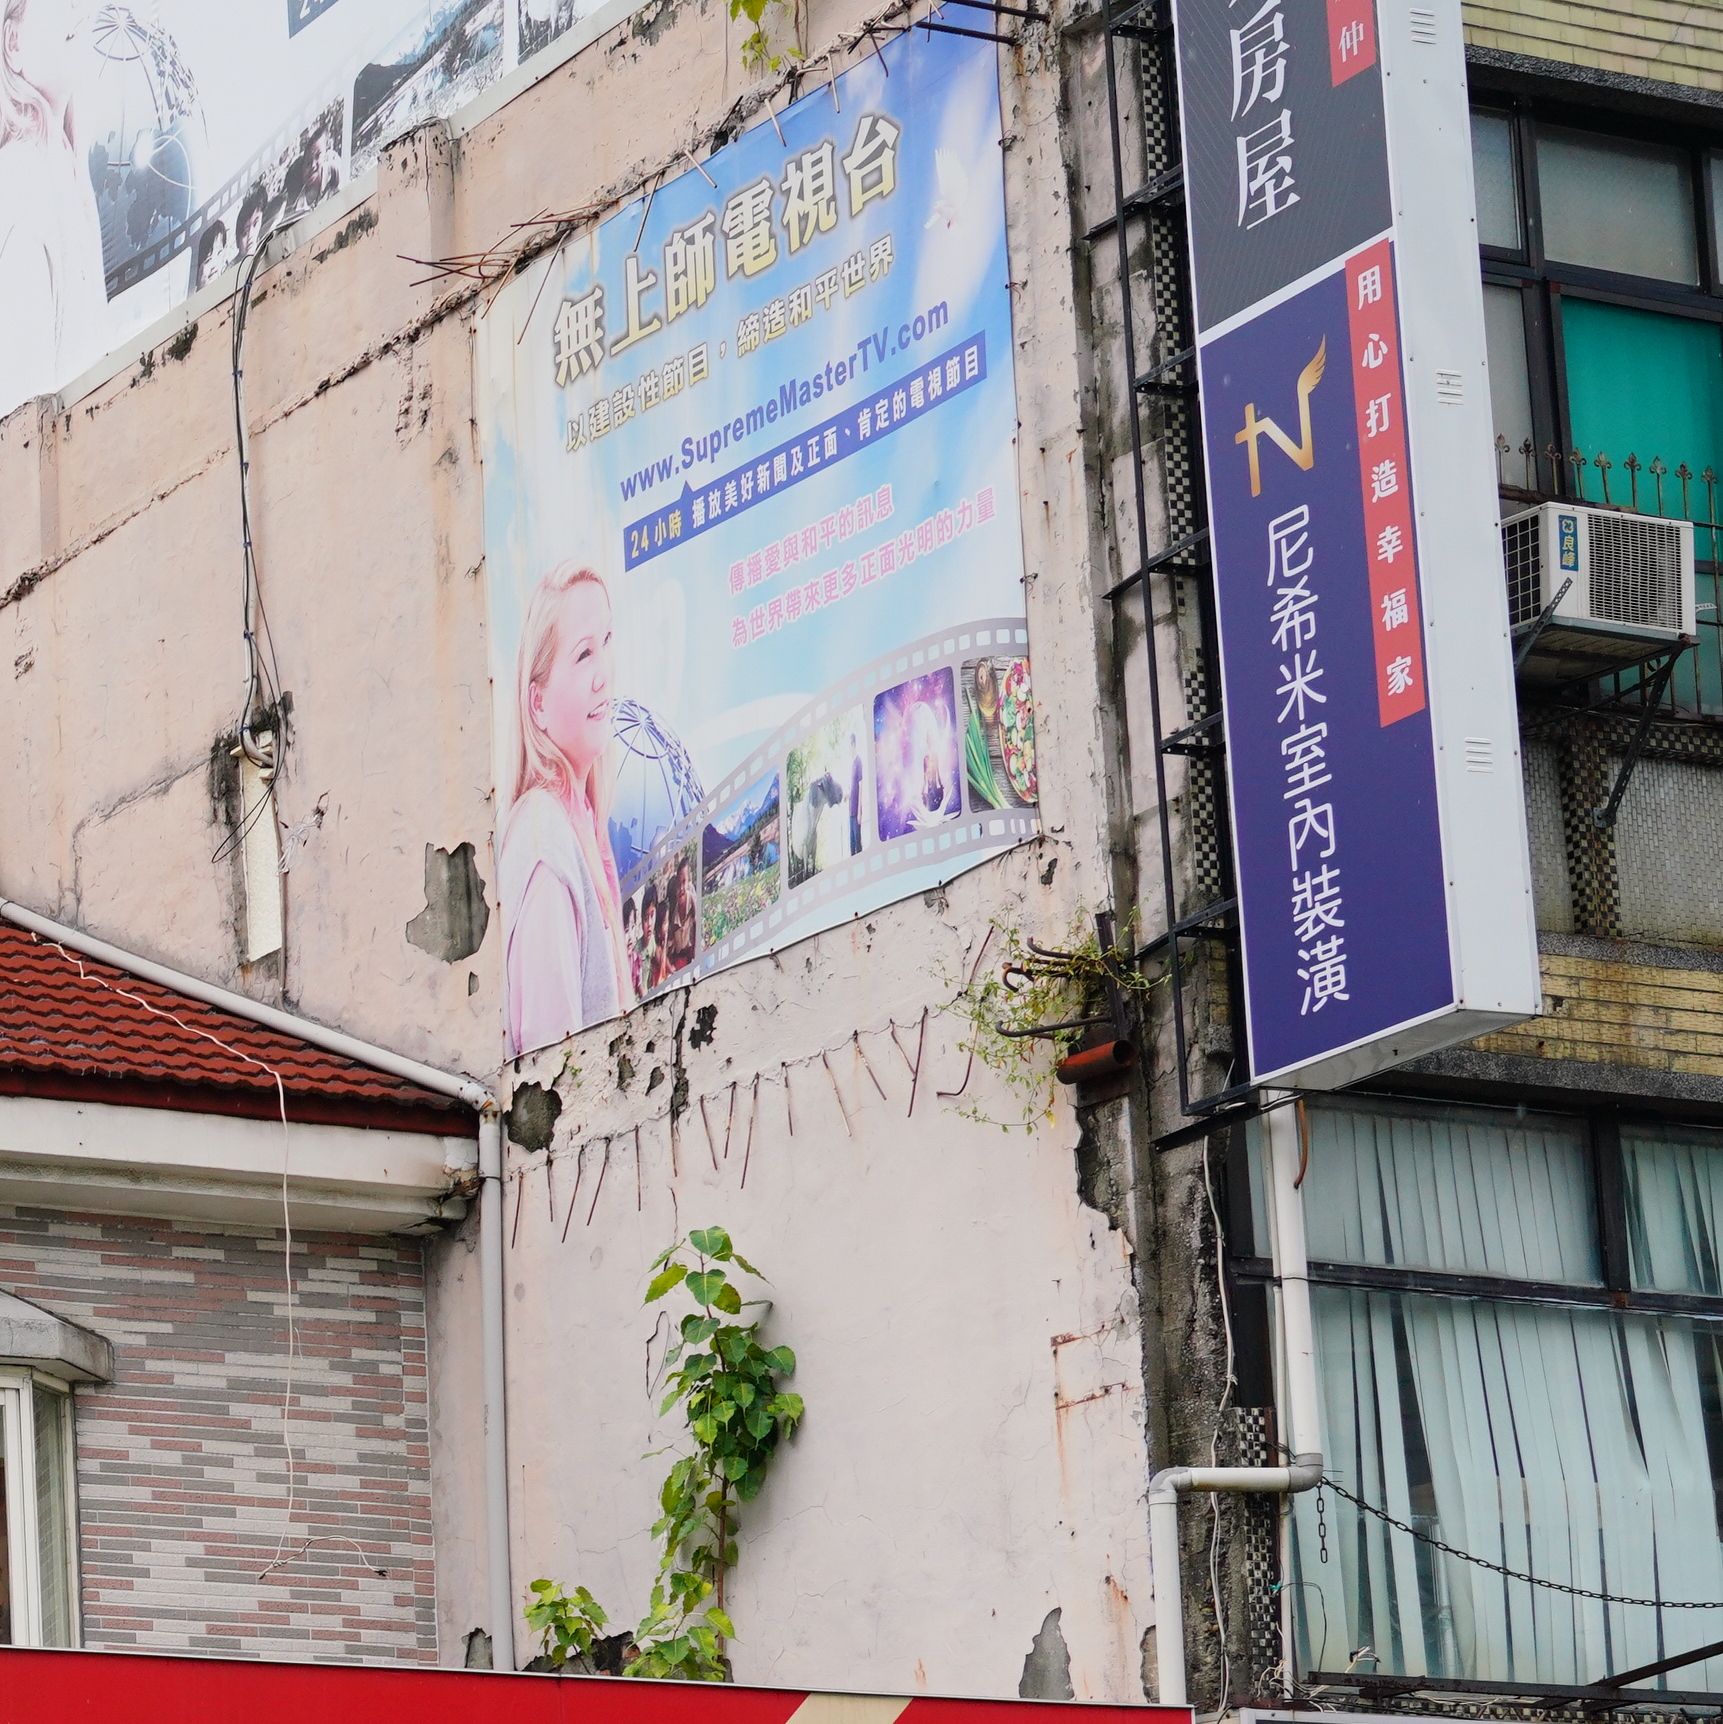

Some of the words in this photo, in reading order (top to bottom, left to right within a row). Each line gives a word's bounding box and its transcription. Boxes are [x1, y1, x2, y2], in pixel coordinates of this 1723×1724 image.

[553, 113, 902, 388] 無上師電視台
[565, 234, 895, 453] 以建設性節目，締造和平世界
[620, 300, 949, 501] www.SupremeMasterTV.com
[1354, 264, 1415, 697] 用心打造幸福家
[728, 484, 894, 596] 傳播愛與和平的訊息
[731, 487, 996, 648] 為世界帶來更多正面光明的力量
[1266, 504, 1351, 1017] 尼希米室內裝潢
